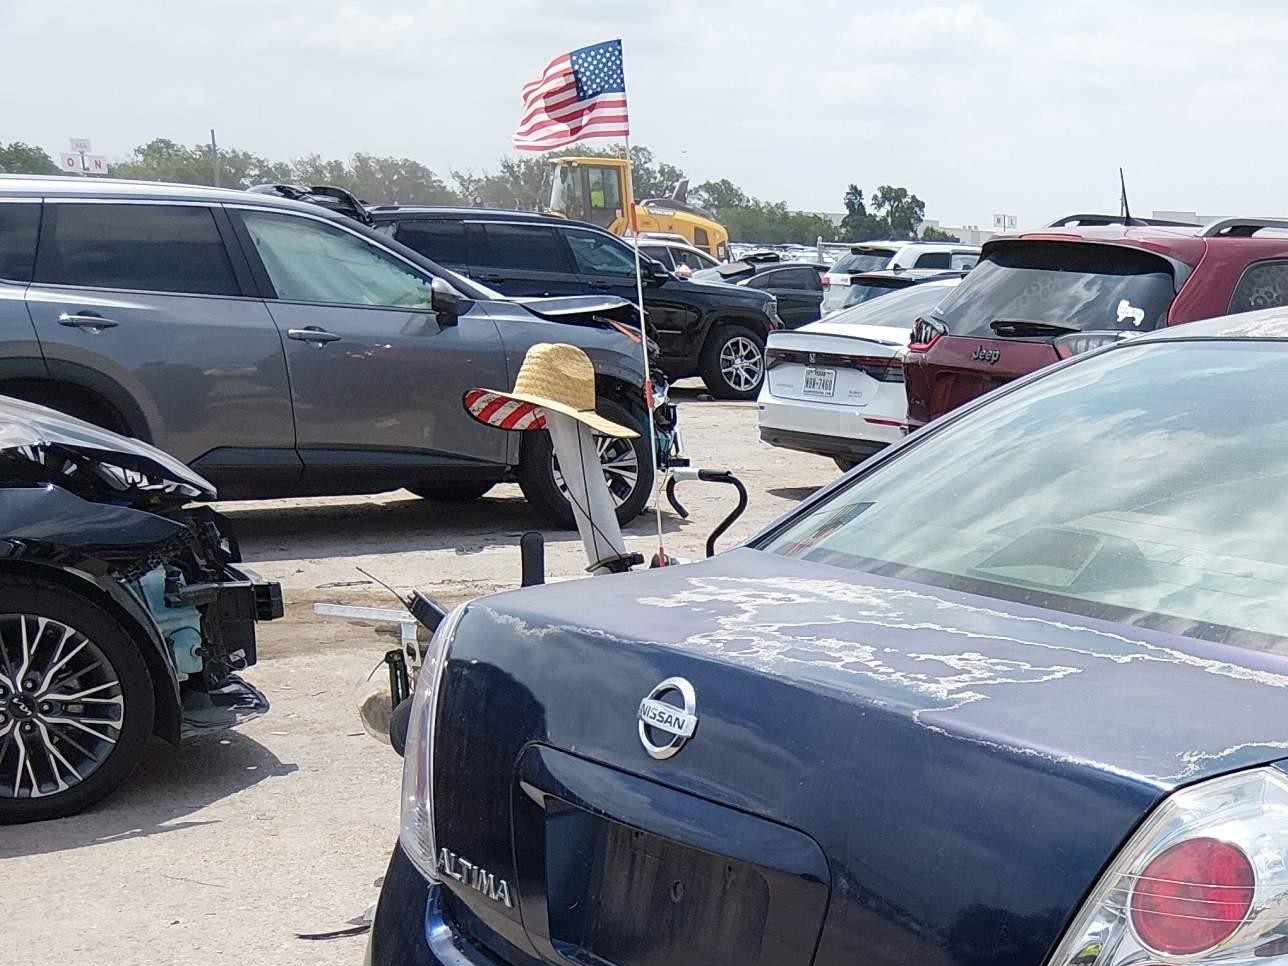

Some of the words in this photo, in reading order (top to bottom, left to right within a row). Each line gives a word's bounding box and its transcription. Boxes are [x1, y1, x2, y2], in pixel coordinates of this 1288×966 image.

[972, 345, 1000, 365] Jeep
[640, 703, 686, 731] NISSAN
[437, 847, 513, 909] ALTIMA
